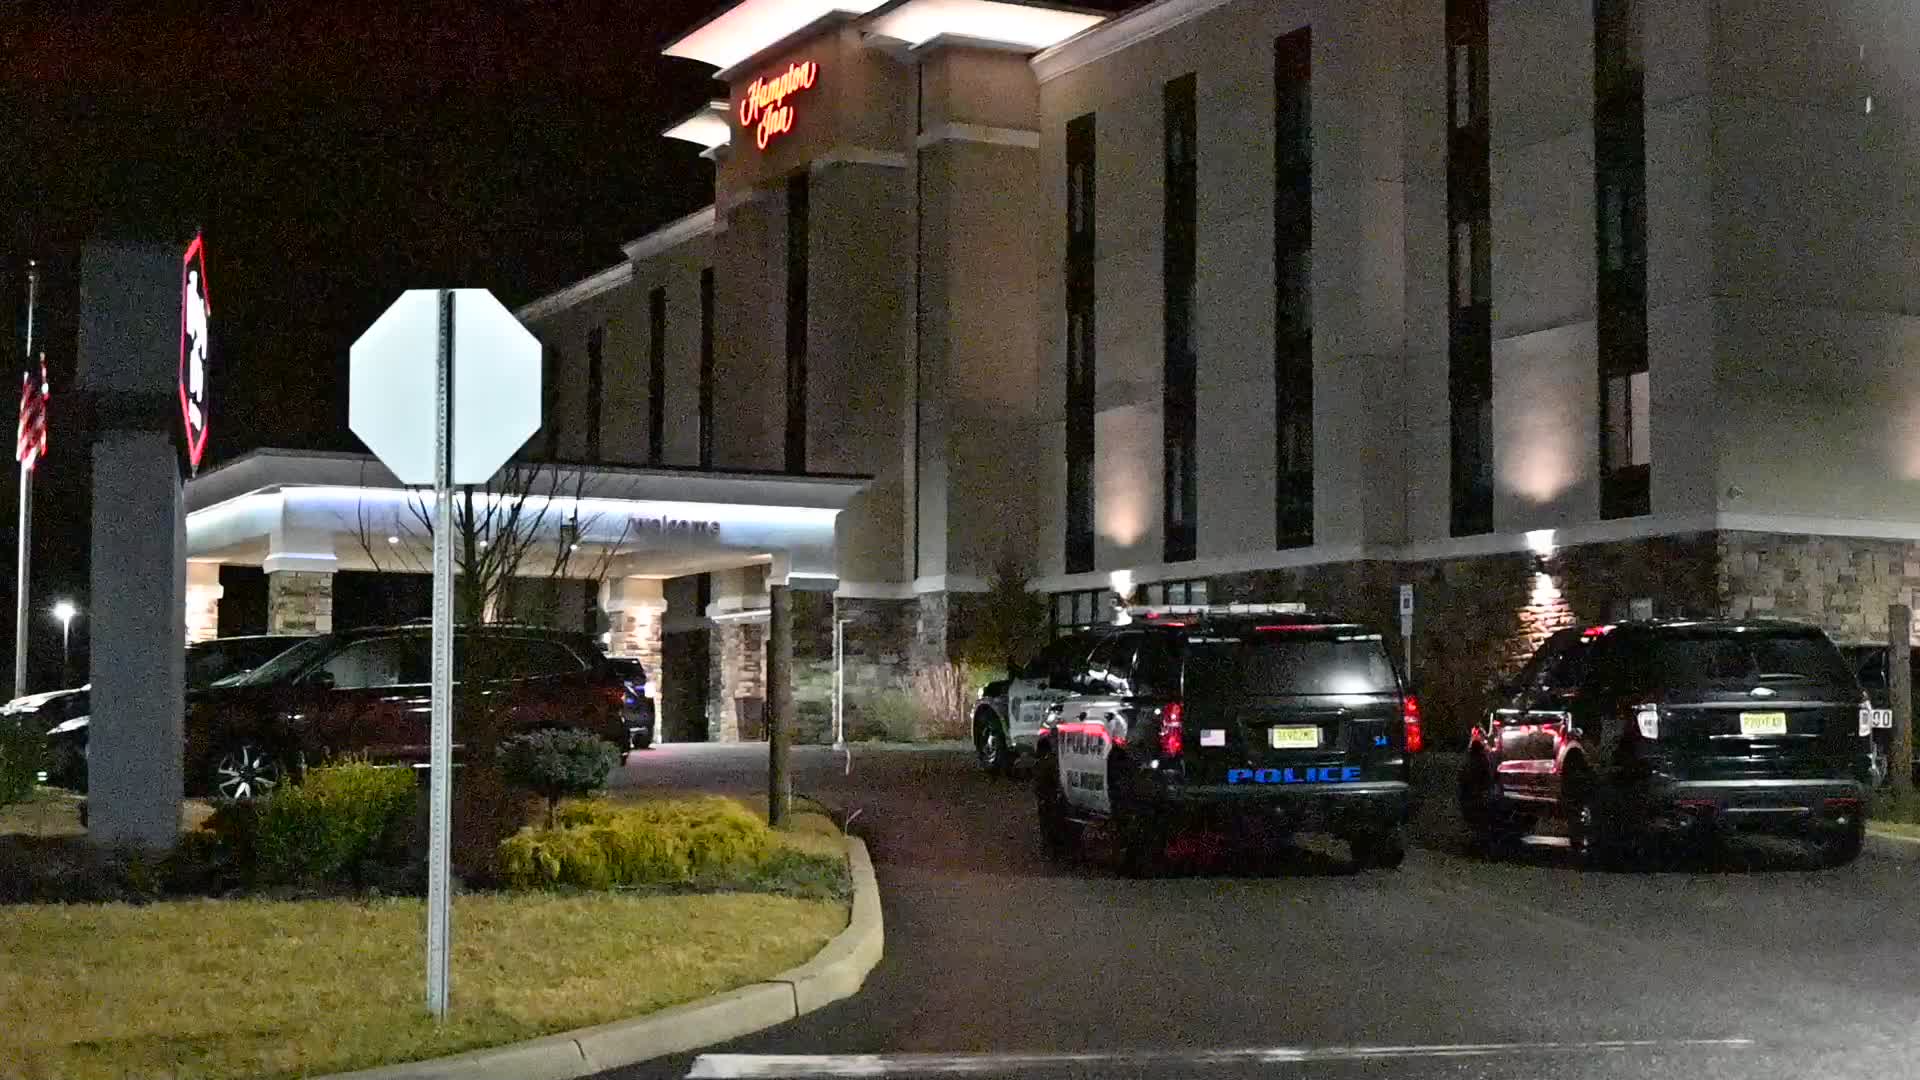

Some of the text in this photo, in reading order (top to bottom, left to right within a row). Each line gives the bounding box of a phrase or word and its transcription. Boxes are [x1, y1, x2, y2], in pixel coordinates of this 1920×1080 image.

[740, 61, 817, 126] Hampton
[757, 104, 794, 150] Inn
[1226, 767, 1361, 784] POLICE
